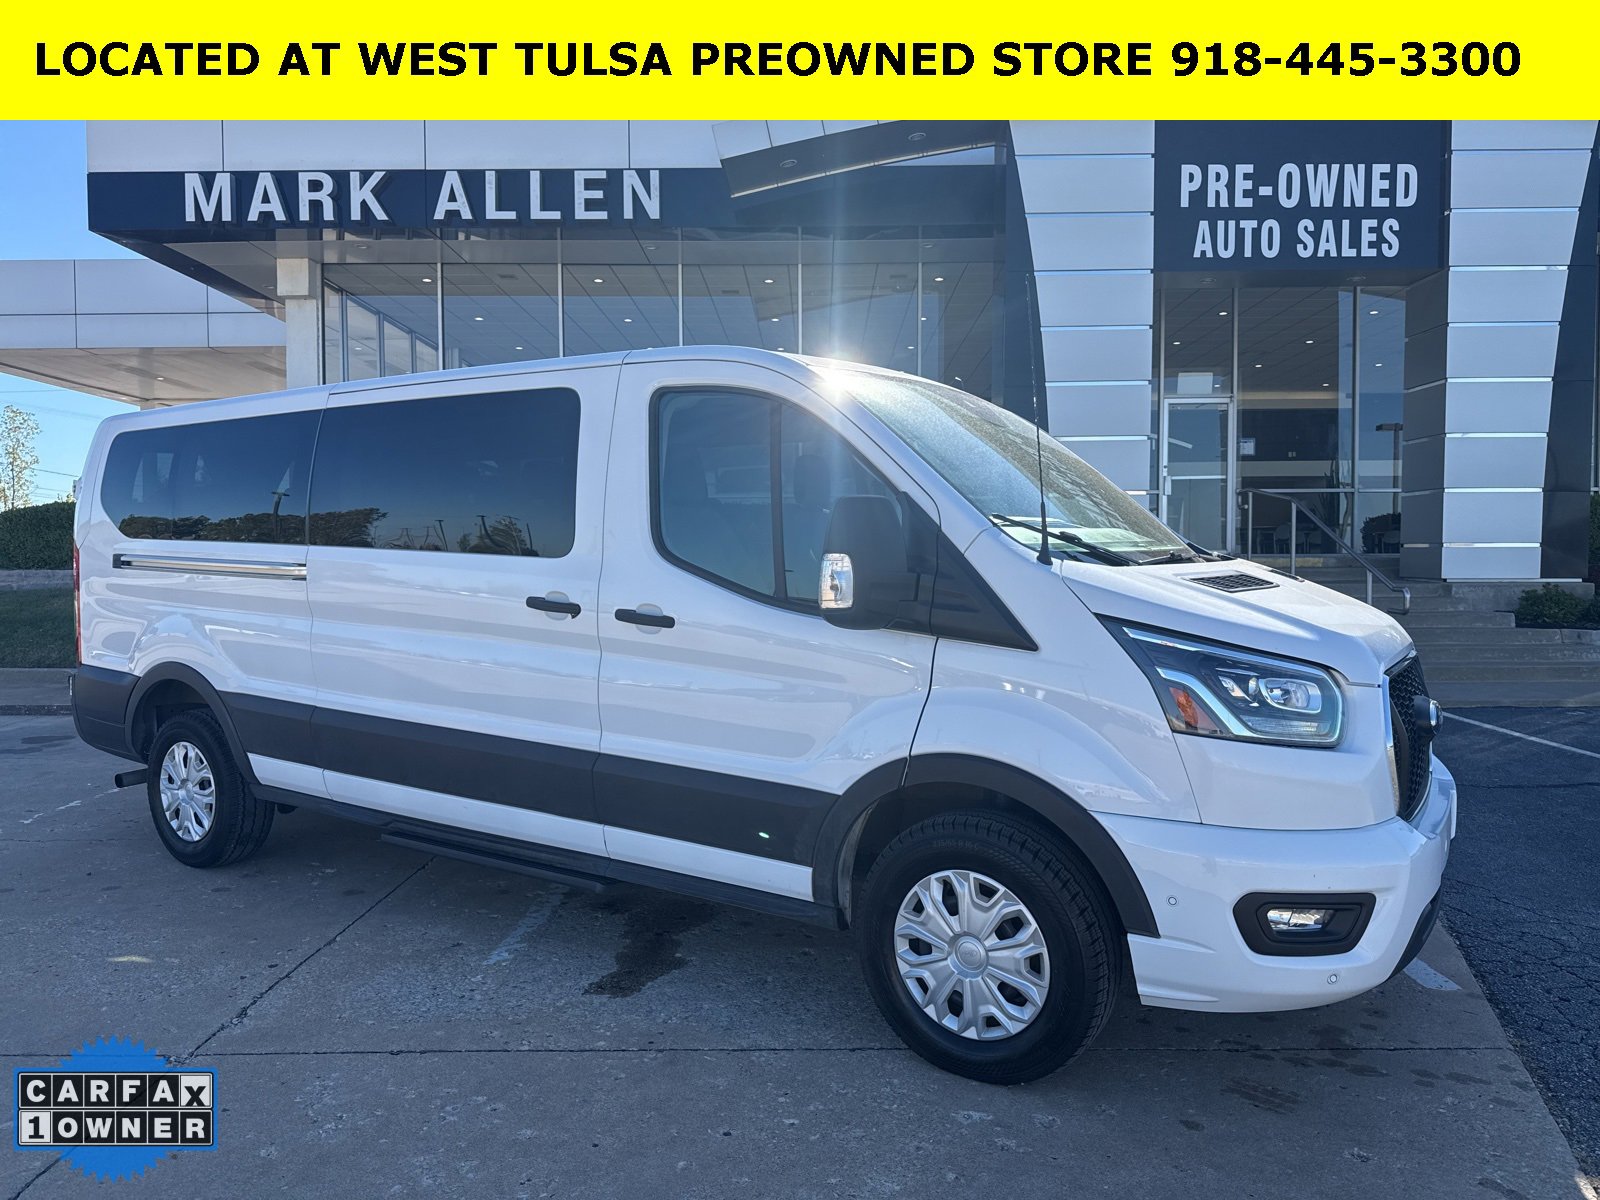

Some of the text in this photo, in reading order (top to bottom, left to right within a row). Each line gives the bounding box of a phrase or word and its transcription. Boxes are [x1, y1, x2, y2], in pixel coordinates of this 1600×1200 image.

[184, 169, 662, 222] MARK ALLEN
[1180, 163, 1418, 208] PRE-OWNED
[1193, 217, 1400, 259] AUTO SALES
